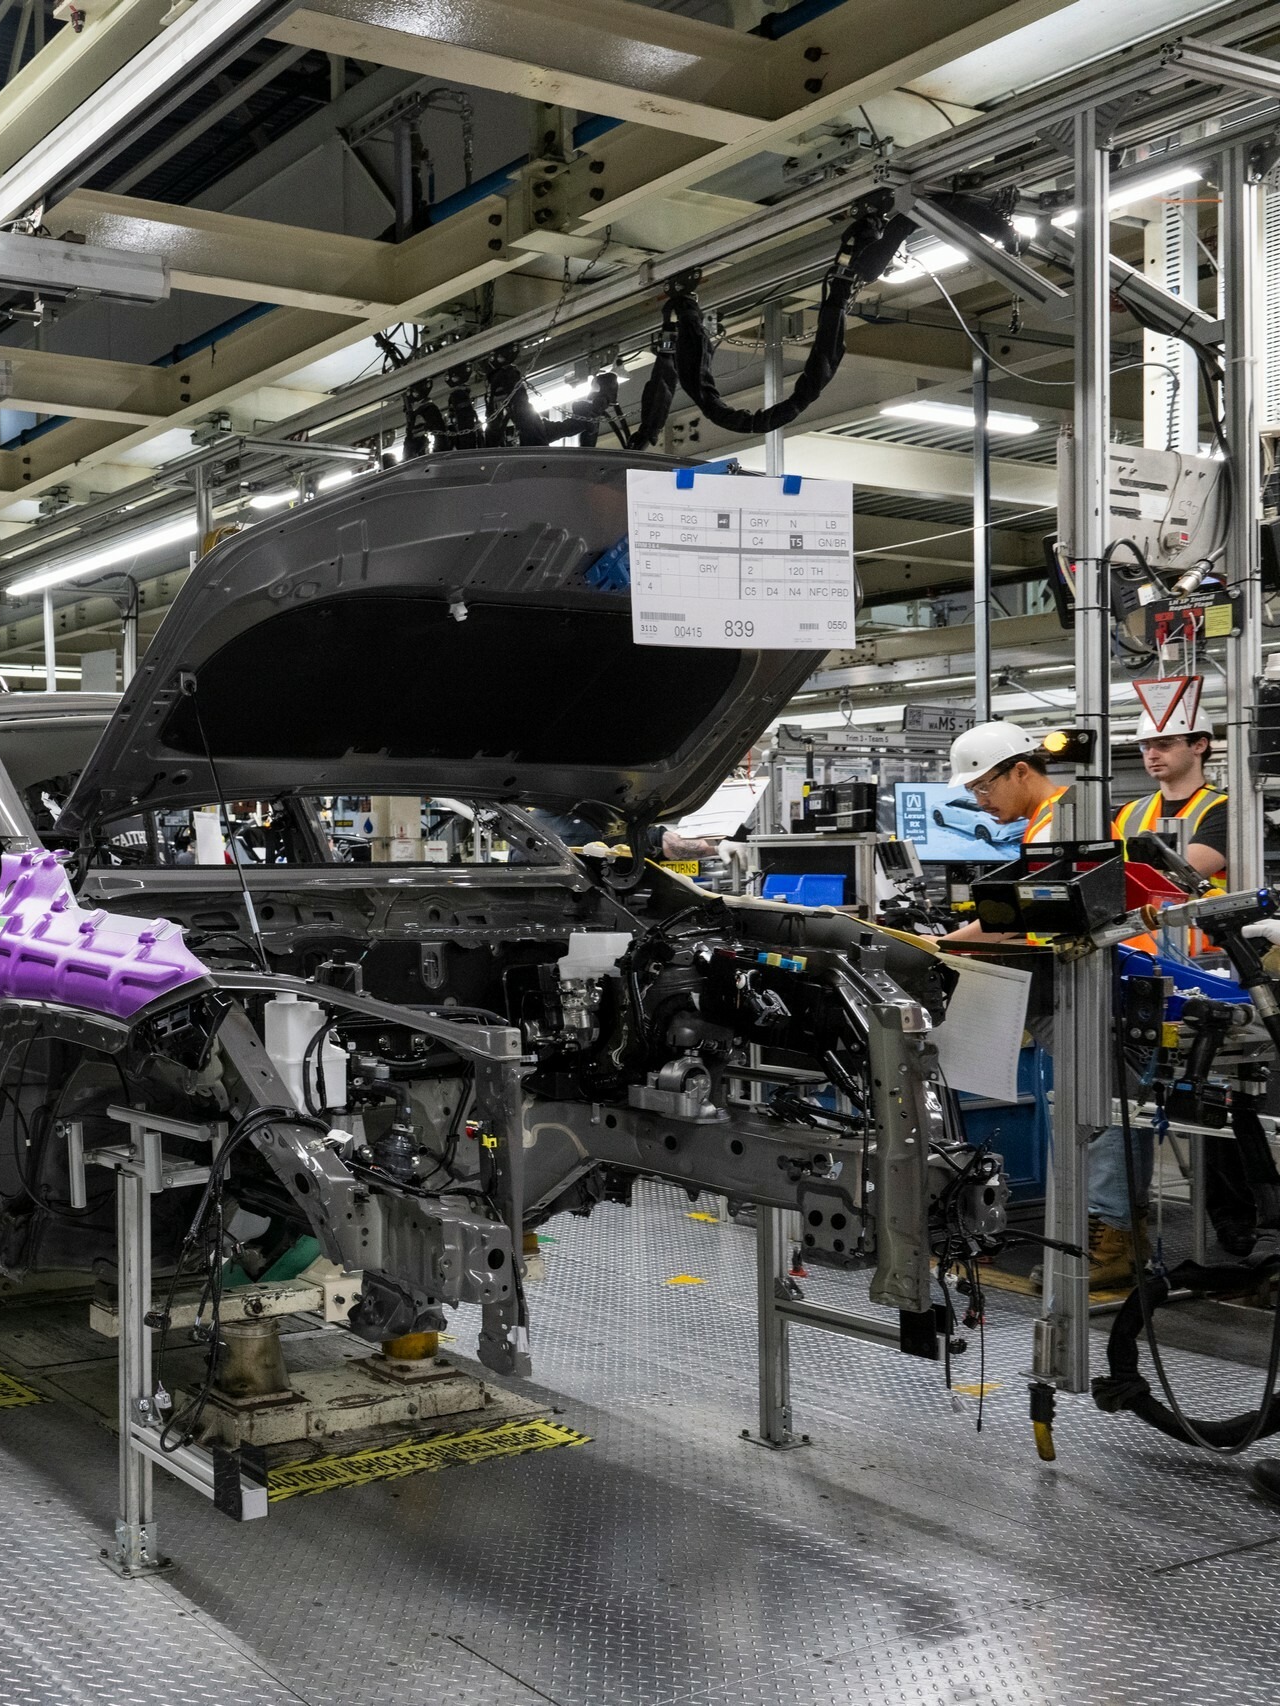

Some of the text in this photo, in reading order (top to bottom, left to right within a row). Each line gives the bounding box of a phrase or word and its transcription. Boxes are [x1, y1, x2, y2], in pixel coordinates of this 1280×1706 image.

[648, 512, 664, 522] L2G
[680, 515, 698, 524] R2G
[750, 518, 769, 527] GRY
[790, 520, 797, 528] N
[826, 521, 836, 529] LB
[650, 531, 661, 540] PP
[680, 533, 698, 542] GRY
[752, 537, 763, 545] C4
[818, 538, 847, 547] GN/BR
[646, 560, 651, 569] E
[700, 564, 718, 573] GRY
[789, 567, 804, 575] 120
[811, 567, 823, 575] TH
[767, 587, 778, 596] D4
[789, 588, 801, 596] N4
[809, 588, 828, 596] NFC
[674, 626, 702, 638] 00415
[724, 620, 754, 638] 839
[828, 621, 847, 630] 0550
[341, 1452, 413, 1477] VEHICLE
[412, 1438, 489, 1466] CHANGES
[486, 1428, 553, 1450] HEIGHT
